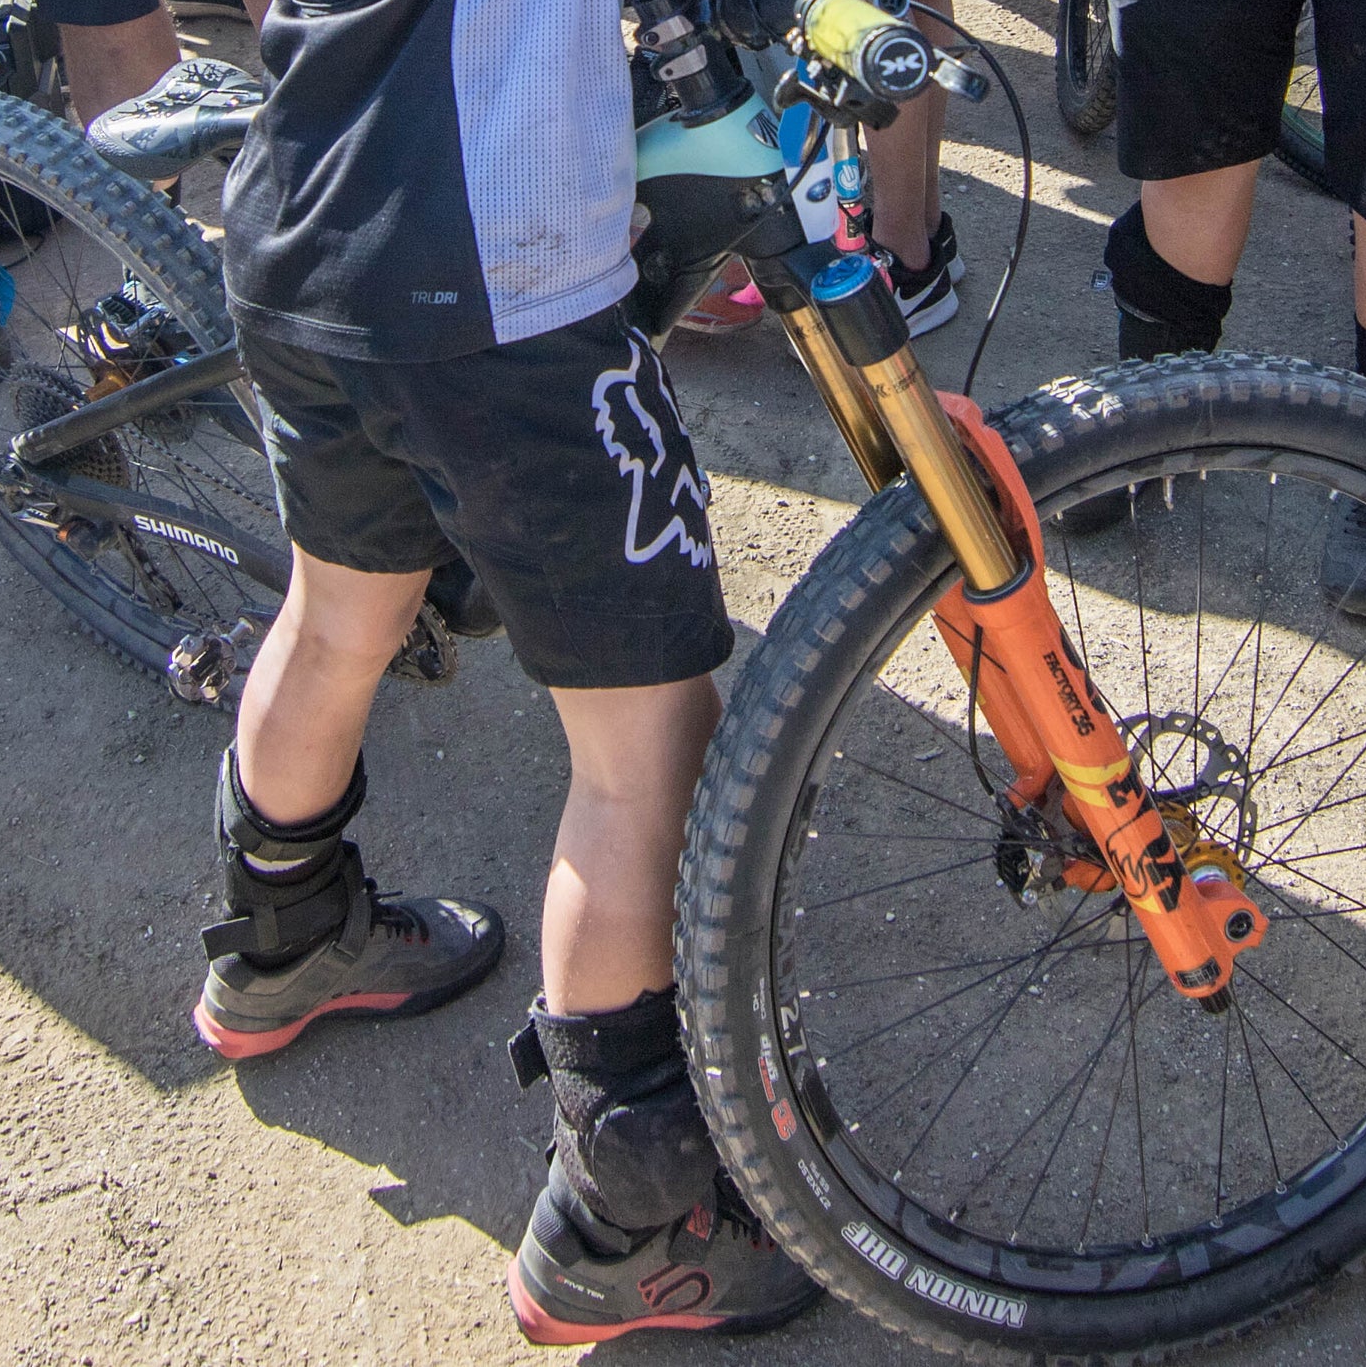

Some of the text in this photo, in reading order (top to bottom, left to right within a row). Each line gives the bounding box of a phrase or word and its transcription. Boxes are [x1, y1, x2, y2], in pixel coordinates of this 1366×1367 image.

[133, 514, 240, 566] SHIMANO
[1042, 650, 1084, 717] FACTORY
[780, 996, 807, 1056] 2.7
[840, 1220, 909, 1280] DHF
[905, 1263, 1029, 1328] MINION
